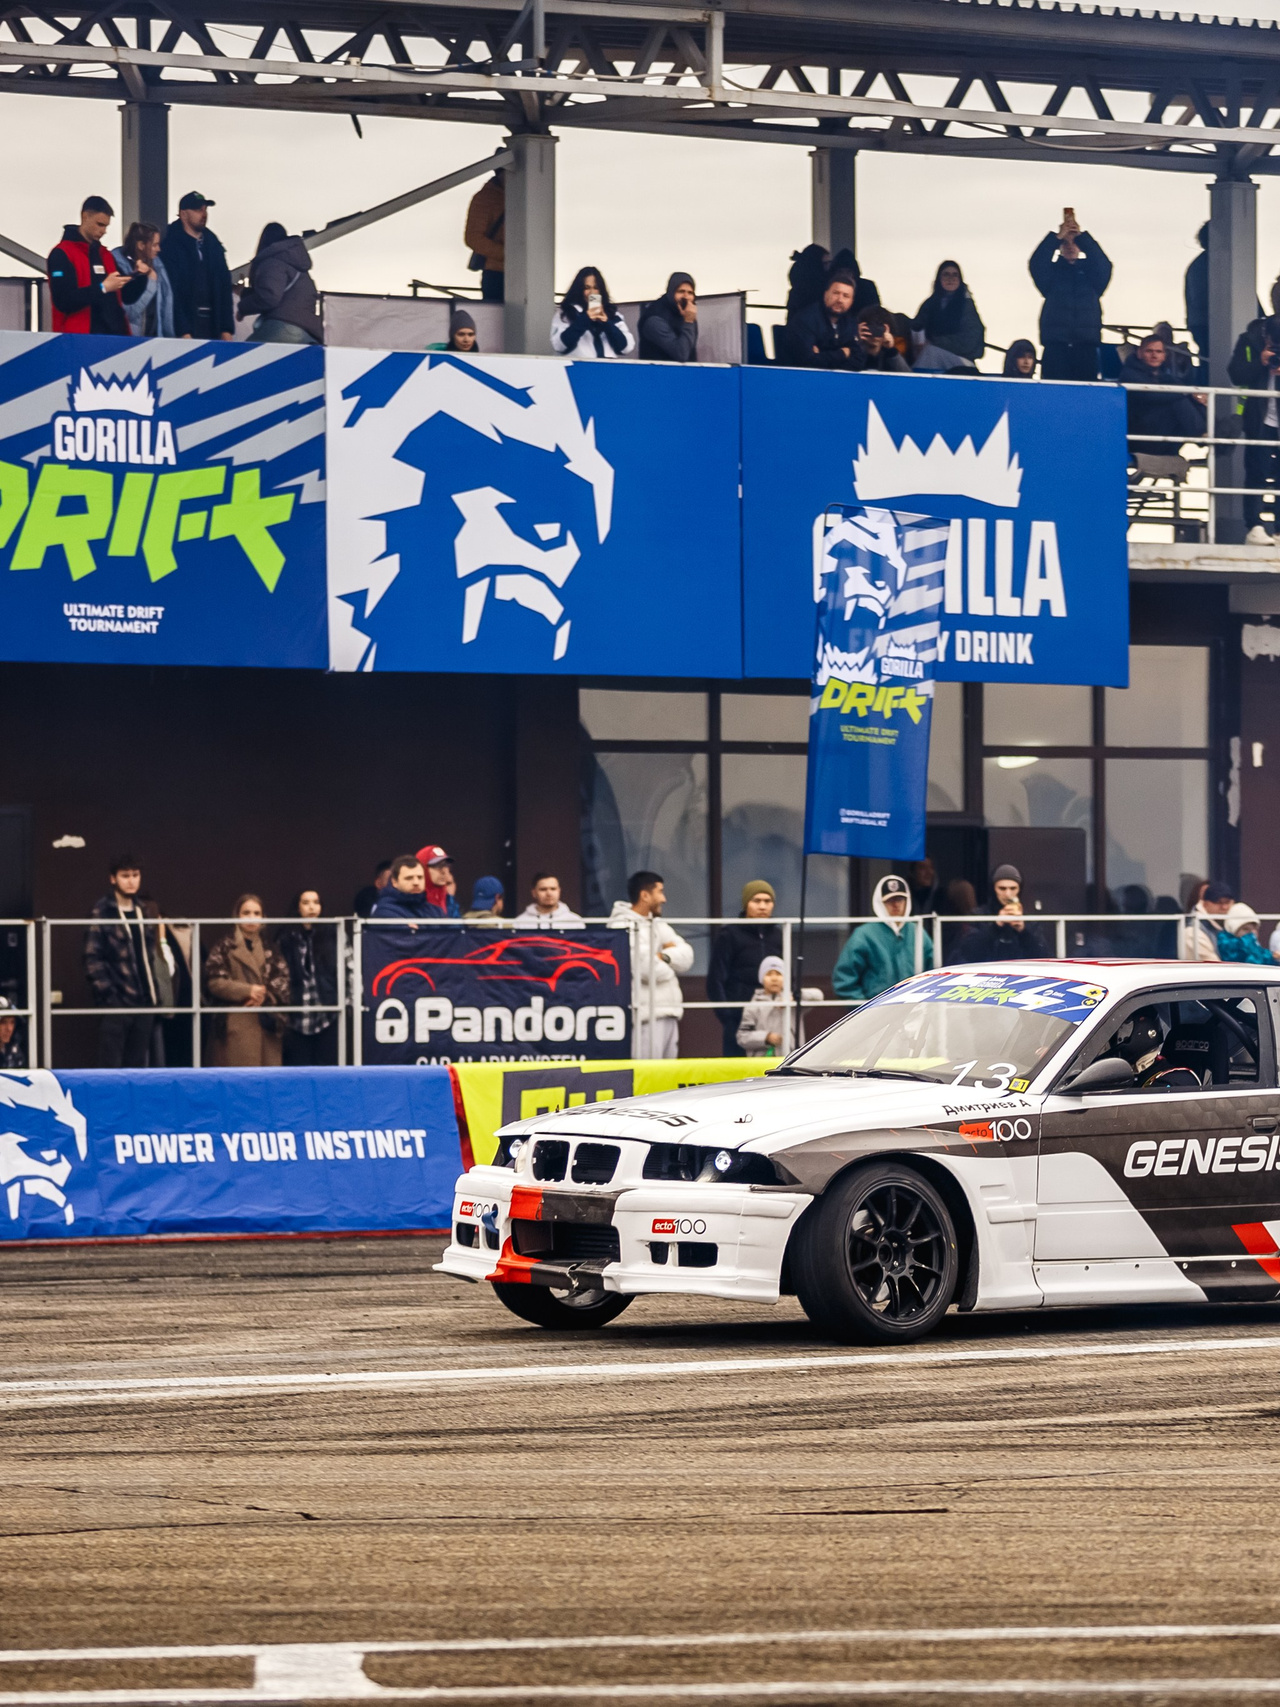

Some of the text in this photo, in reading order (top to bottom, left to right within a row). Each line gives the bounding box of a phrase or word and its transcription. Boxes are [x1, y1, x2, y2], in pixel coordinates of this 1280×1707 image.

[53, 416, 177, 465] GORILLA
[63, 603, 165, 621] ULTIMATE DRIFT
[69, 617, 159, 634] TOURNAMENT
[956, 630, 1034, 665] DRINK
[819, 676, 928, 725] DRIFT
[414, 996, 626, 1043] Pandora
[951, 1060, 1018, 1097] 13
[942, 1102, 1017, 1116] Дмитриев
[115, 1129, 427, 1164] POWER YOUR INSTINCT
[653, 1218, 707, 1235] ecto100
